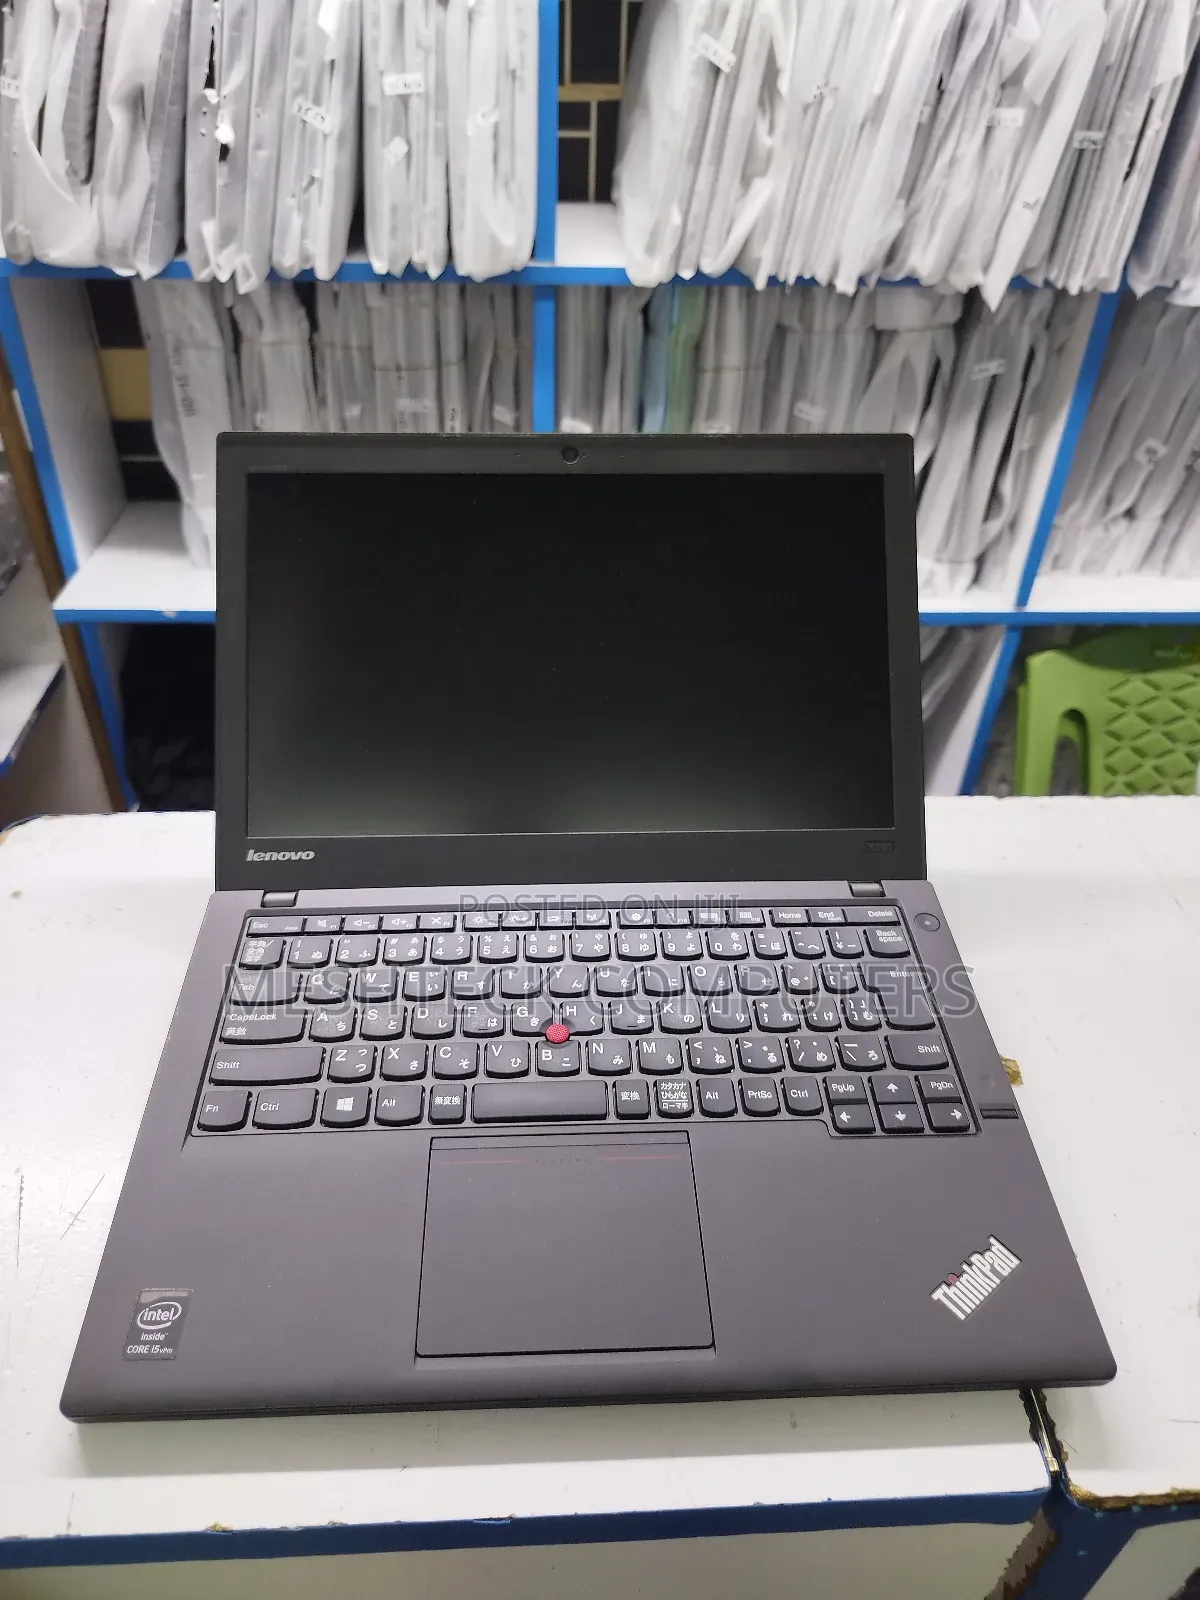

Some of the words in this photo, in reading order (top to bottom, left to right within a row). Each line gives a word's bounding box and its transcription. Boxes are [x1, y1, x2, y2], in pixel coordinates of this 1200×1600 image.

[246, 849, 315, 861] lenovo
[253, 921, 269, 929] Esc
[878, 935, 903, 943] space
[435, 947, 444, 955] 4
[456, 947, 464, 955] う
[483, 946, 491, 954] 5
[502, 946, 511, 954] え
[529, 945, 538, 954] 6
[547, 945, 557, 953] お
[575, 944, 584, 953] 7
[593, 943, 604, 952] や
[621, 943, 630, 952] 8
[640, 943, 649, 952] ゆ
[667, 943, 676, 951] 9
[687, 943, 696, 951] よ
[732, 943, 742, 951] わ
[294, 950, 300, 960] 1
[340, 950, 350, 959] 2
[388, 948, 397, 957] 3
[407, 948, 418, 956] あ
[694, 966, 706, 976] O
[312, 973, 325, 985] Q
[409, 972, 419, 982] E
[428, 983, 438, 991] い
[457, 971, 468, 981] R
[476, 980, 487, 990] す
[554, 968, 564, 978] Y
[572, 979, 582, 988] ん
[600, 967, 610, 978] U
[621, 978, 630, 987] な
[668, 978, 678, 986] に
[791, 977, 800, 986] @
[238, 983, 254, 991] Tab
[362, 972, 377, 983] W
[379, 984, 389, 993] て
[522, 980, 534, 989] か
[229, 1012, 277, 1021] CapsLock
[467, 1007, 477, 1018] F
[487, 1018, 498, 1027] は
[516, 1006, 528, 1017] G
[530, 1017, 539, 1026] き
[566, 1005, 577, 1016] H
[589, 1015, 596, 1026] く
[615, 1003, 623, 1014] J
[637, 1015, 646, 1024] ま
[664, 1003, 674, 1014] K
[684, 1015, 694, 1023] の
[712, 1003, 721, 1014] L
[736, 1013, 745, 1022] り
[316, 1011, 328, 1021] A
[337, 1021, 347, 1031] ち
[367, 1009, 378, 1020] S
[388, 1020, 397, 1030] と
[417, 1008, 428, 1018] D
[438, 1018, 447, 1028] し
[225, 1027, 247, 1036] 英数
[592, 1042, 603, 1054] N
[613, 1056, 624, 1065] み
[643, 1042, 656, 1053] M
[666, 1054, 675, 1064] も
[918, 1045, 941, 1053] Shift
[335, 1050, 347, 1061] Z
[388, 1047, 400, 1059] X
[409, 1060, 419, 1070] さ
[439, 1046, 452, 1058] C
[460, 1058, 470, 1069] そ
[491, 1045, 503, 1056] V
[510, 1058, 521, 1067] ひ
[541, 1050, 552, 1061] B
[561, 1057, 571, 1067] こ
[714, 1054, 726, 1064] ね
[767, 1053, 777, 1063] る
[816, 1052, 827, 1062] め
[868, 1050, 878, 1061] ろ
[216, 1061, 240, 1069] Shift
[355, 1063, 367, 1072] つ
[660, 1082, 687, 1090] カタカナ
[831, 1083, 855, 1092] PgUp
[930, 1081, 954, 1090] PgDn
[620, 1091, 640, 1100] 変換
[661, 1090, 688, 1099] ひらがな
[705, 1091, 719, 1099] Alt
[747, 1090, 773, 1099] PrtSc
[790, 1088, 808, 1098] Ctrl
[381, 1098, 396, 1107] Alt
[434, 1096, 461, 1105] 無変換
[205, 1104, 219, 1113] Fn
[260, 1102, 280, 1111] Ctrl
[662, 1102, 688, 1110] ローマ字
[931, 1236, 1020, 1320] ThinkPad
[143, 1307, 175, 1321] intel
[126, 1344, 150, 1354] CORE
